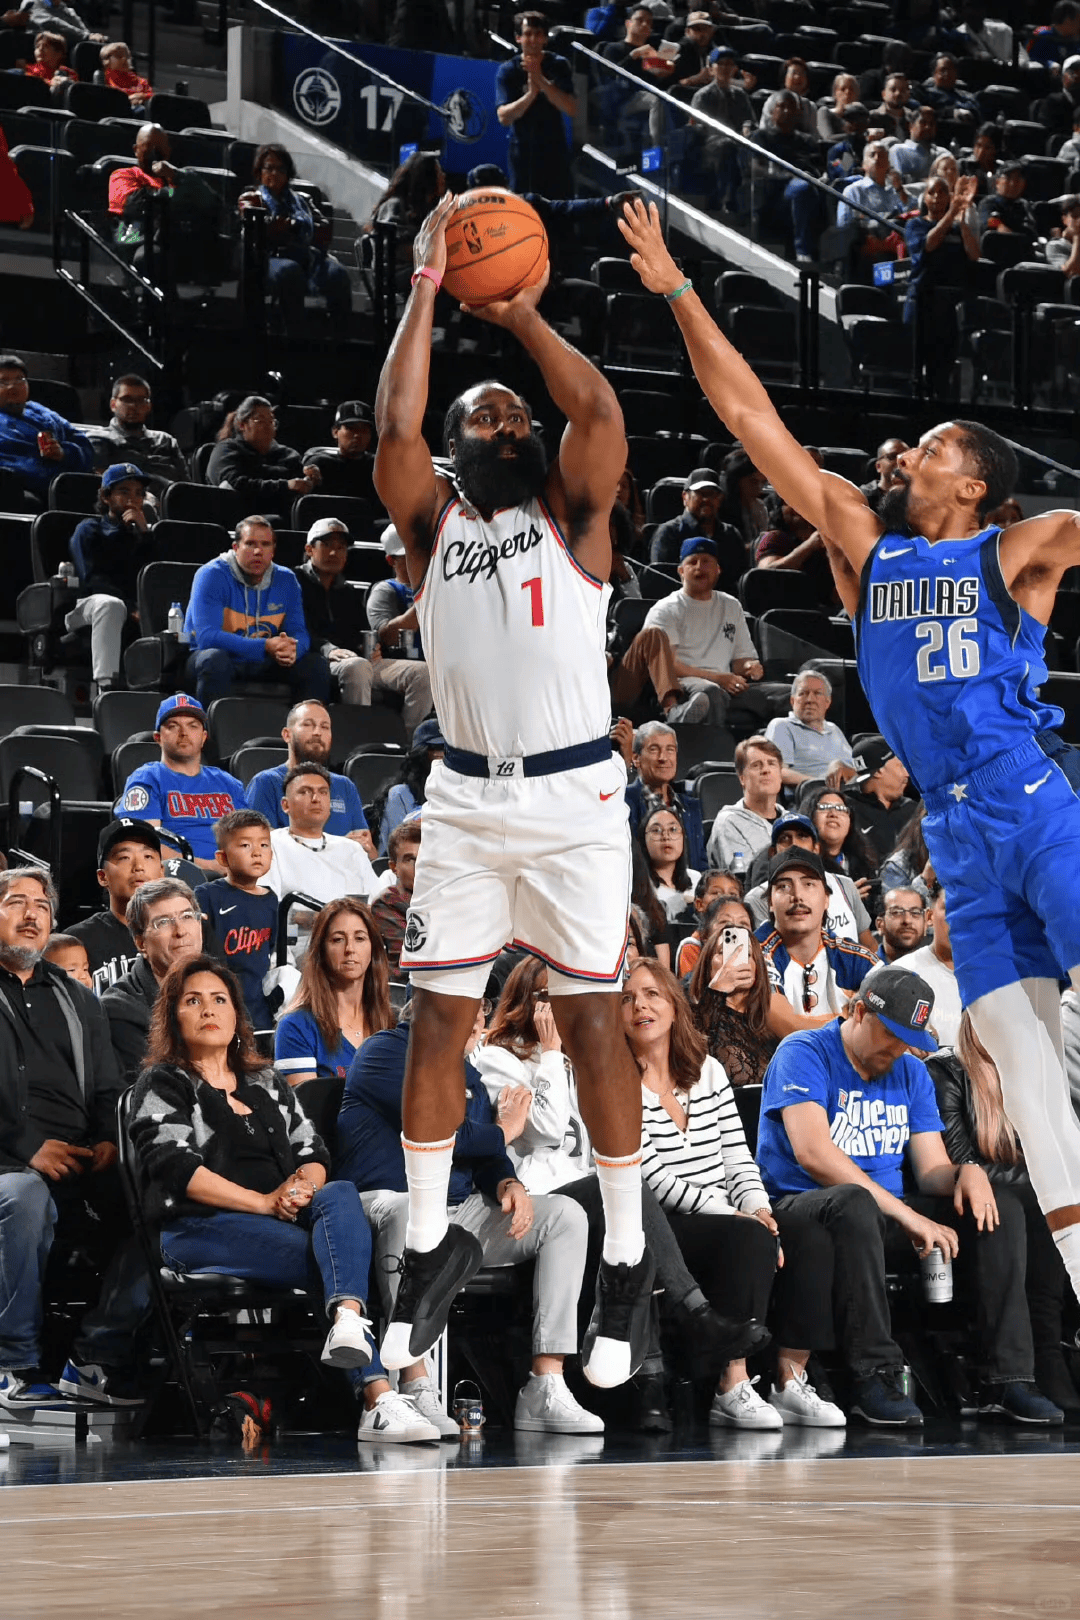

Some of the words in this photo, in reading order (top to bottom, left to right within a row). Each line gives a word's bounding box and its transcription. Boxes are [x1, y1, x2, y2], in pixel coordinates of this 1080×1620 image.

[360, 85, 403, 131] 17
[443, 524, 543, 584] Clippers
[521, 577, 545, 627] 1
[870, 577, 980, 624] DALLAS
[915, 617, 981, 683] 26
[469, 1412, 481, 1420] 310
